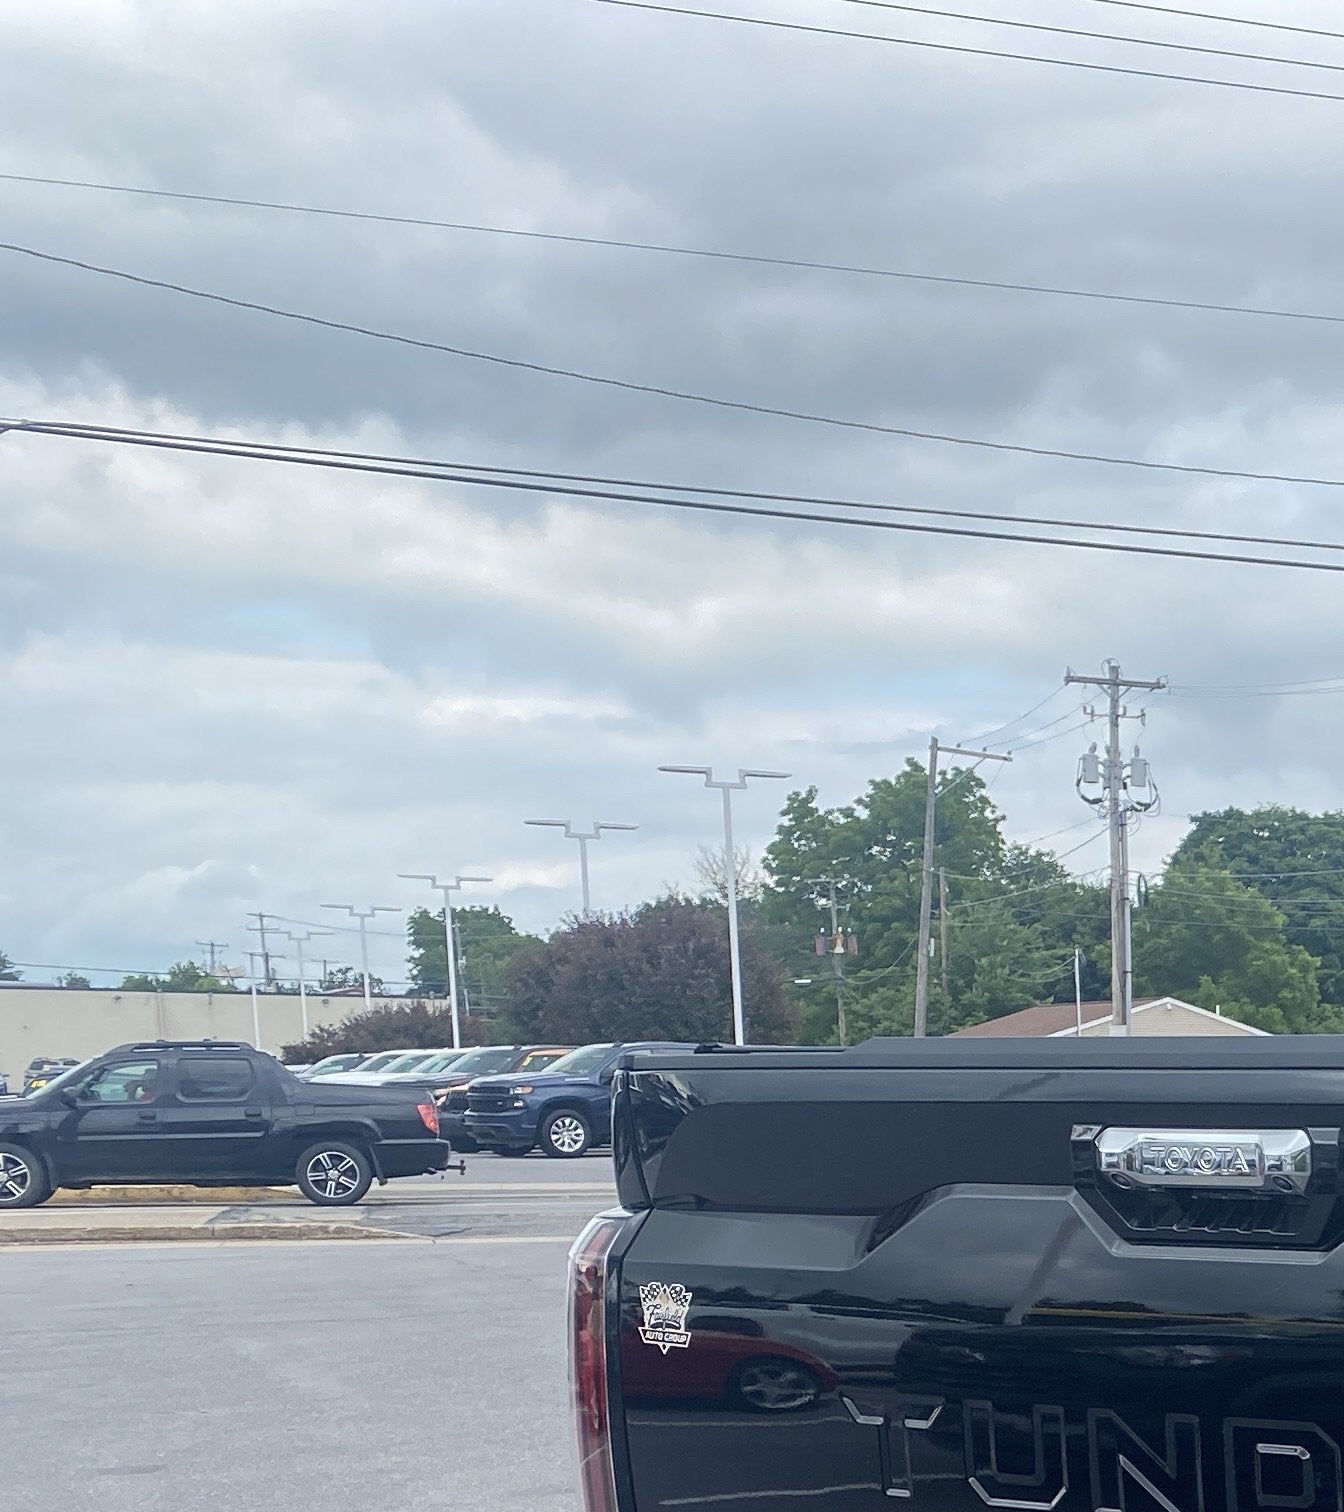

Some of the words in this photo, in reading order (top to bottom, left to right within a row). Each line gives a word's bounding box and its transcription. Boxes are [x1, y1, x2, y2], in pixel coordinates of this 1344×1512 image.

[1149, 1145, 1250, 1173] TOYOTA
[645, 1330, 663, 1341] AUTO
[664, 1332, 687, 1343] GROUP
